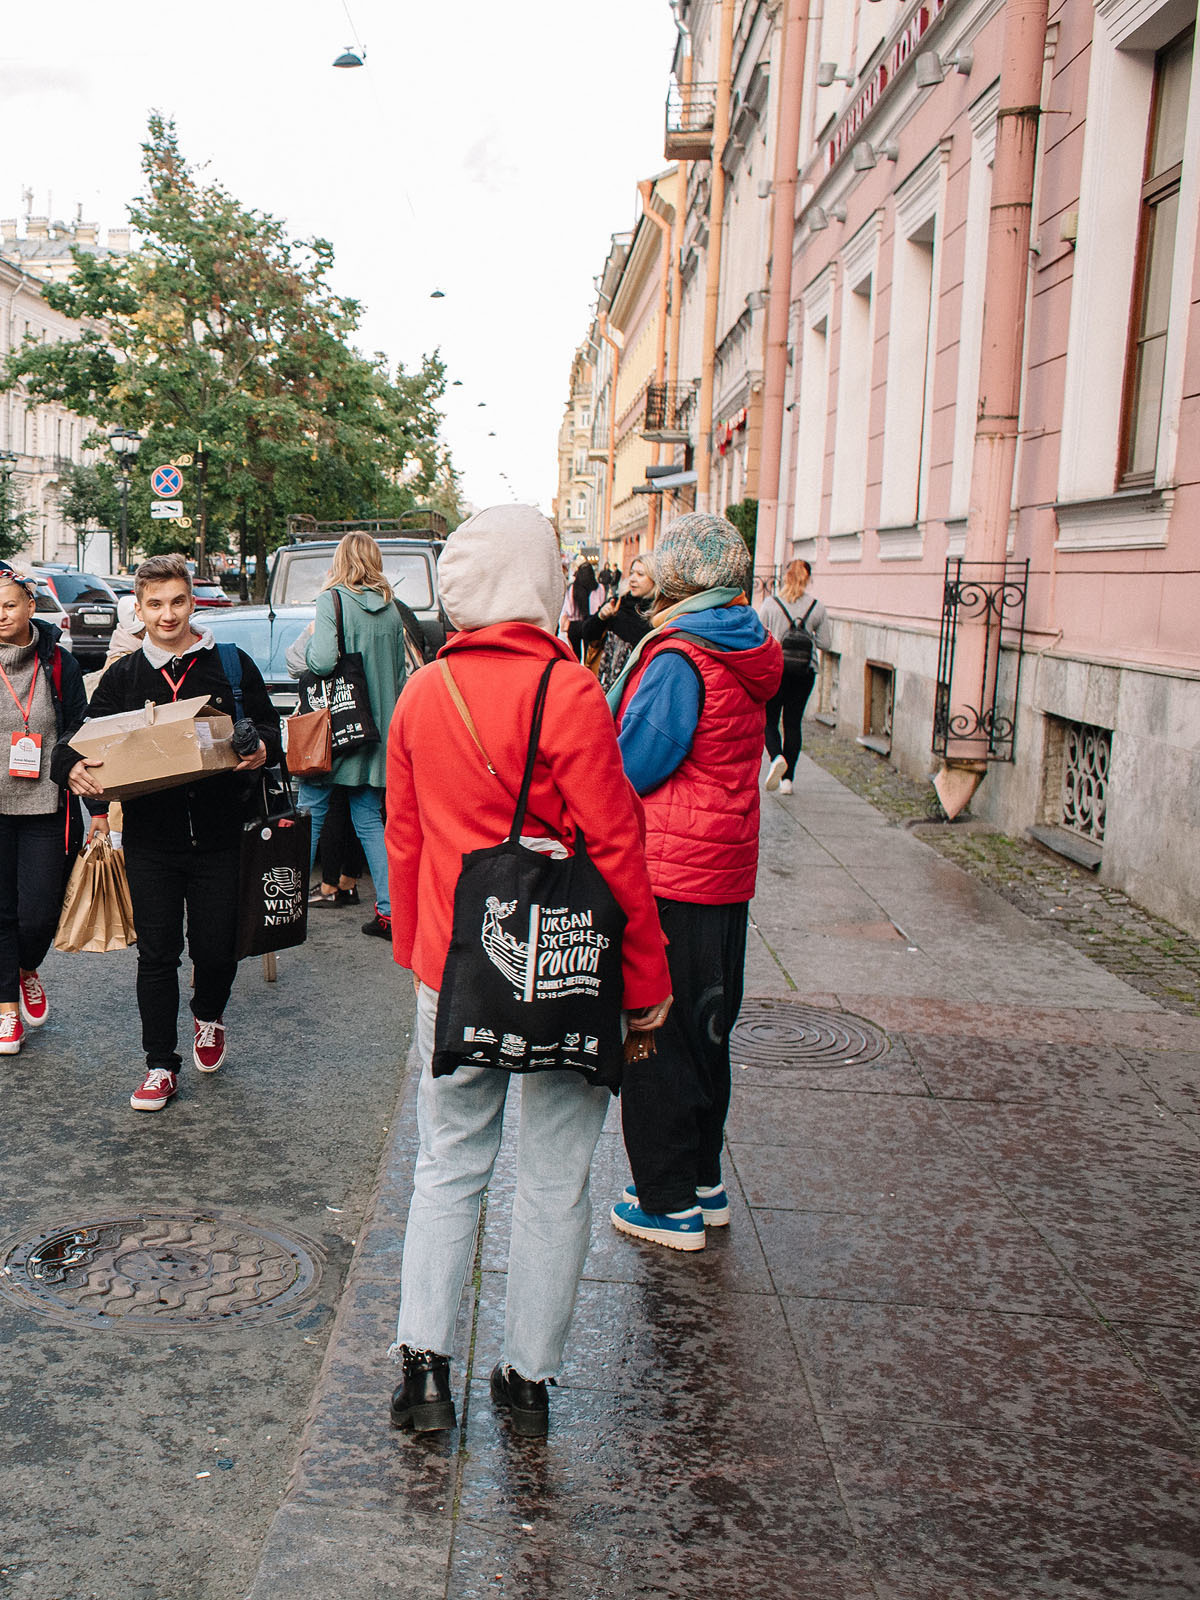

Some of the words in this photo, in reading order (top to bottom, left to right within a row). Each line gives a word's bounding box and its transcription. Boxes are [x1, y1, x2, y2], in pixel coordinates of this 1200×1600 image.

[541, 909, 593, 933] URBAN
[537, 929, 611, 950] SKETCHERS
[538, 945, 601, 976] РОССИЯ
[536, 975, 602, 990] САНКТ-ПЕТЕРБУРГ
[535, 991, 558, 1000] 13-15
[584, 987, 600, 997] 2019
